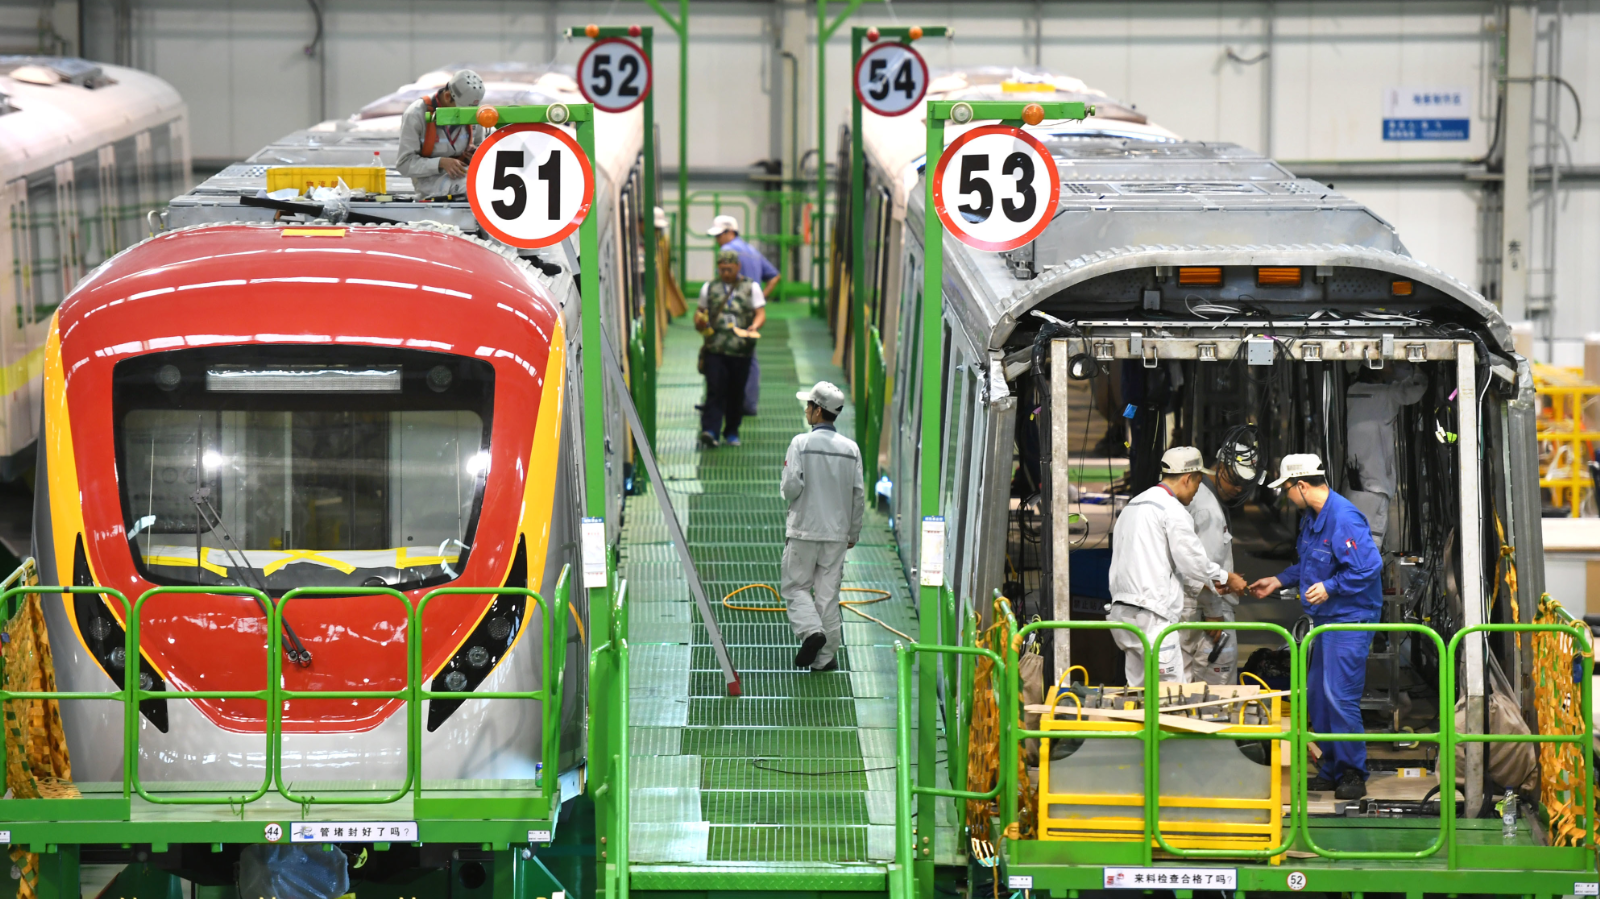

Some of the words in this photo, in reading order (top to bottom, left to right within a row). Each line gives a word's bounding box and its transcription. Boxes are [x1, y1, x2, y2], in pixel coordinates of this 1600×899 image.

[591, 54, 640, 97] 52
[868, 58, 917, 101] 54
[491, 150, 561, 221] 51
[957, 151, 1037, 223] 53
[267, 826, 279, 836] 44
[1290, 875, 1303, 885] 52
